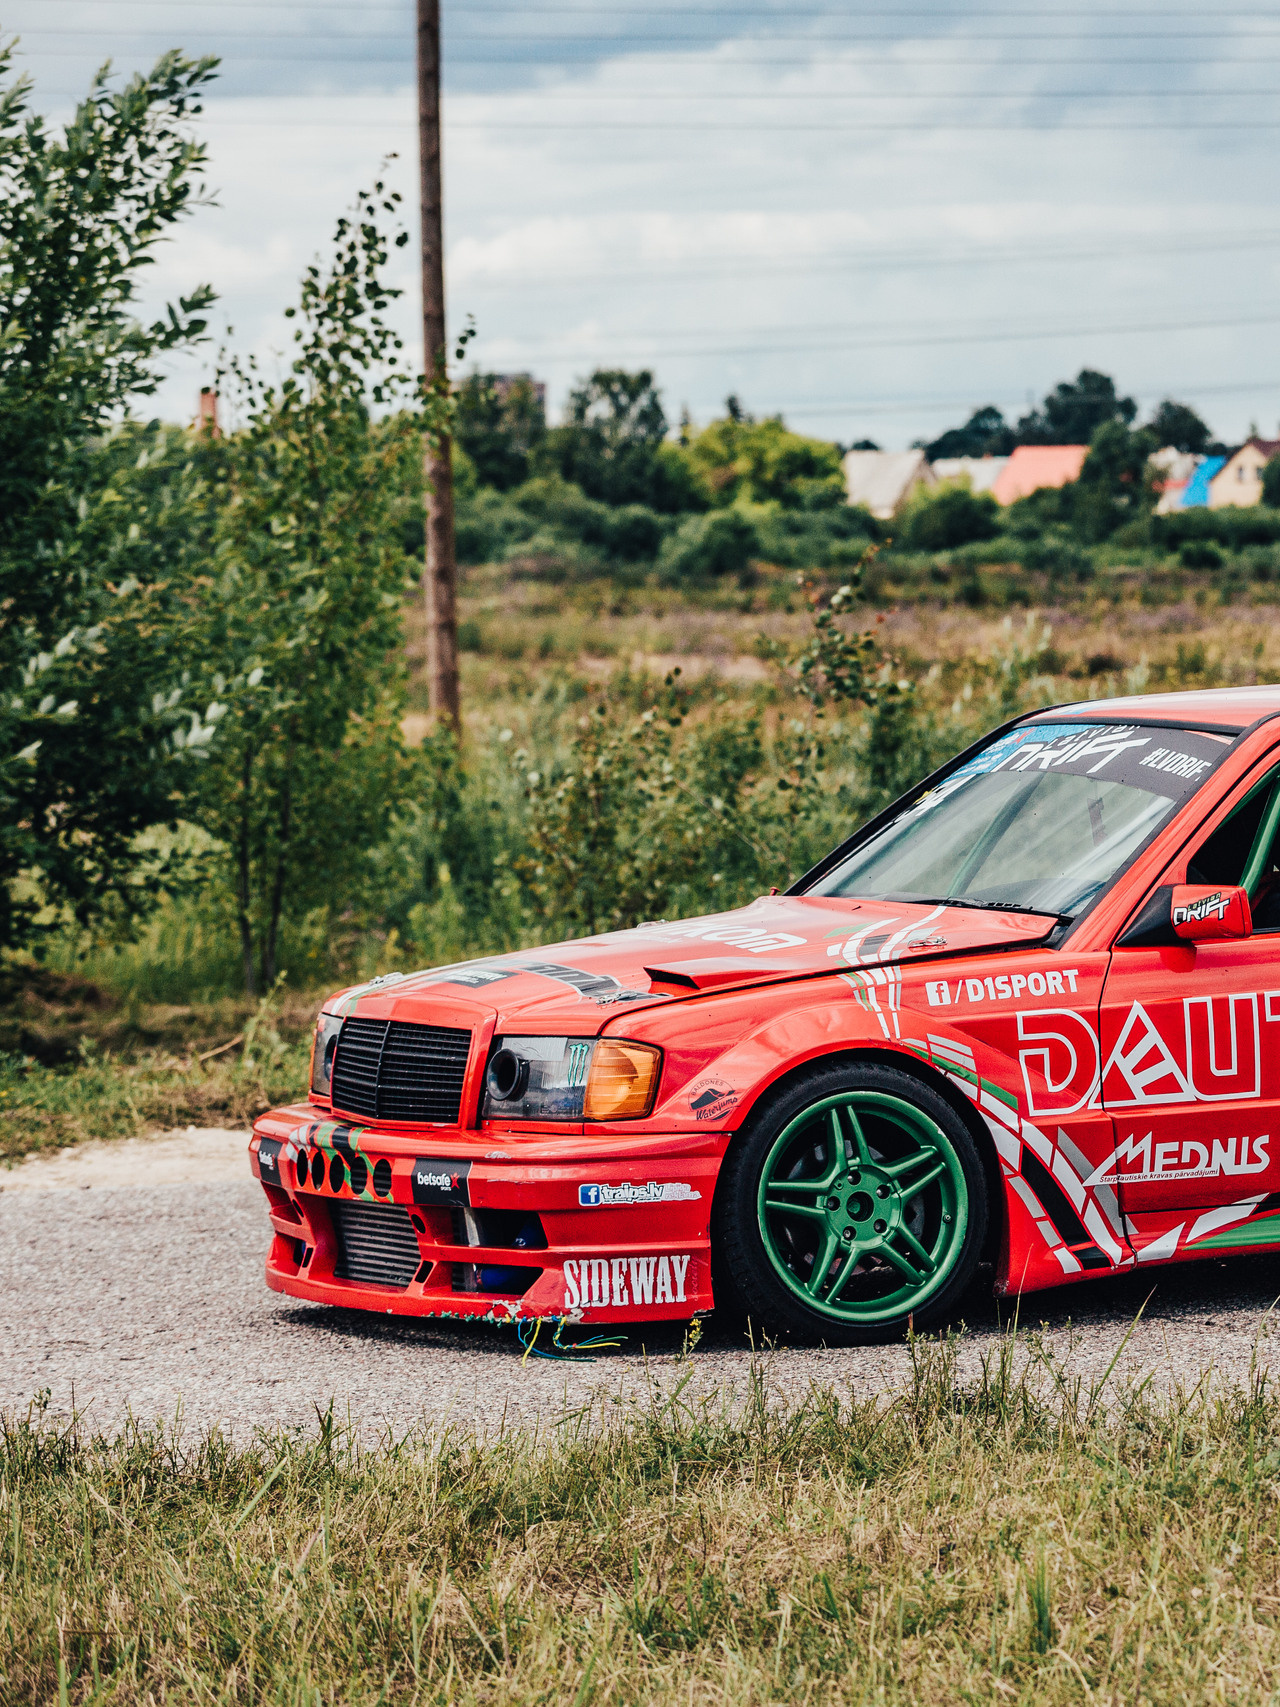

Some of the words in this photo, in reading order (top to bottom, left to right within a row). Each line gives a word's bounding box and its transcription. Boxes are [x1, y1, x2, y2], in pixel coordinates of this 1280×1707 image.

[1042, 725, 1140, 751] Latvia
[1173, 899, 1230, 926] DRIFT
[1083, 1131, 1271, 1187] MEDNIS
[417, 1172, 451, 1187] betsafe
[1149, 1172, 1173, 1180] kravas
[601, 1182, 664, 1202] traips.lv
[563, 1254, 691, 1309] SIDEWAY
